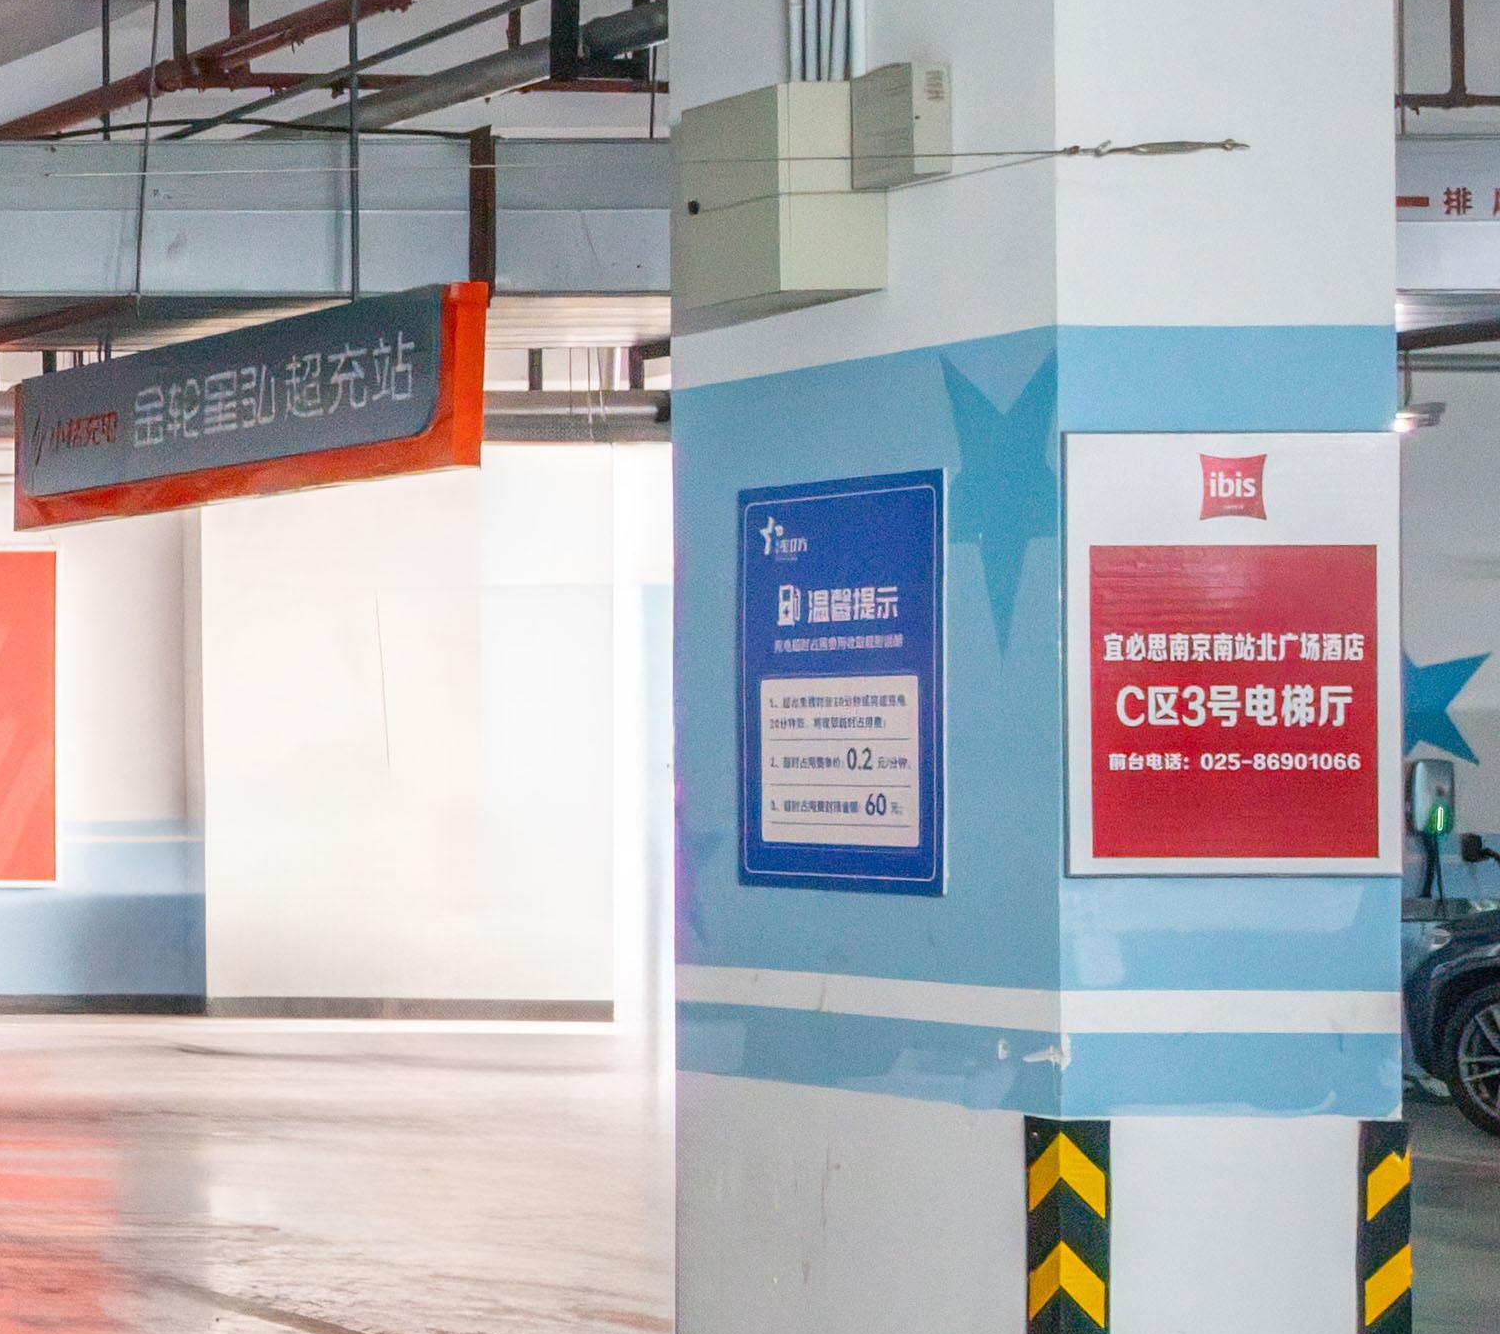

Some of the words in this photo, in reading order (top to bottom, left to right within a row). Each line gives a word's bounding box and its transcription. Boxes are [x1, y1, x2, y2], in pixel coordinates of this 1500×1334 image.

[1208, 471, 1257, 498] ibis
[807, 586, 899, 624] 温馨提示
[1103, 632, 1365, 662] 宜必思南京南站北广场酒店
[1115, 683, 1354, 727] C区3号电梯厅
[846, 746, 874, 771] 0.2
[864, 792, 888, 816] 60
